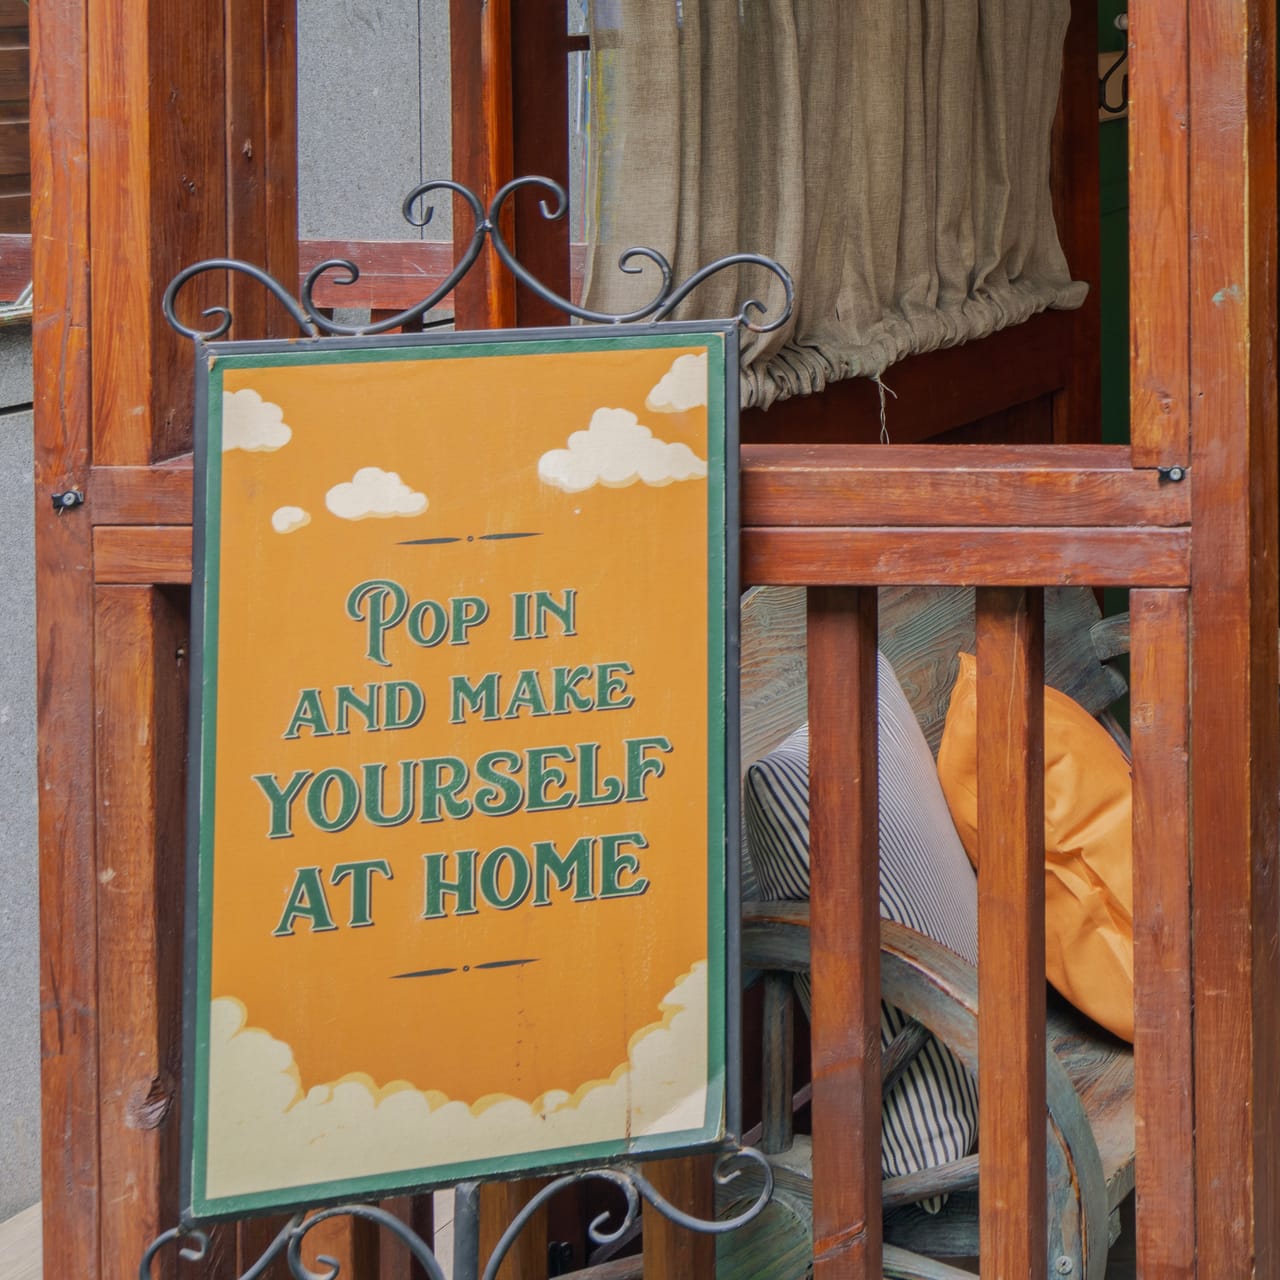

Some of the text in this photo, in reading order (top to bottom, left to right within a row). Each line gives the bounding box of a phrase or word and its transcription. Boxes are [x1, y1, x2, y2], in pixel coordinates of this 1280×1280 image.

[511, 589, 578, 640] IN
[282, 662, 634, 740] AND MAKE
[252, 736, 673, 839] YOURSELF
[272, 832, 650, 936] AT HOME
